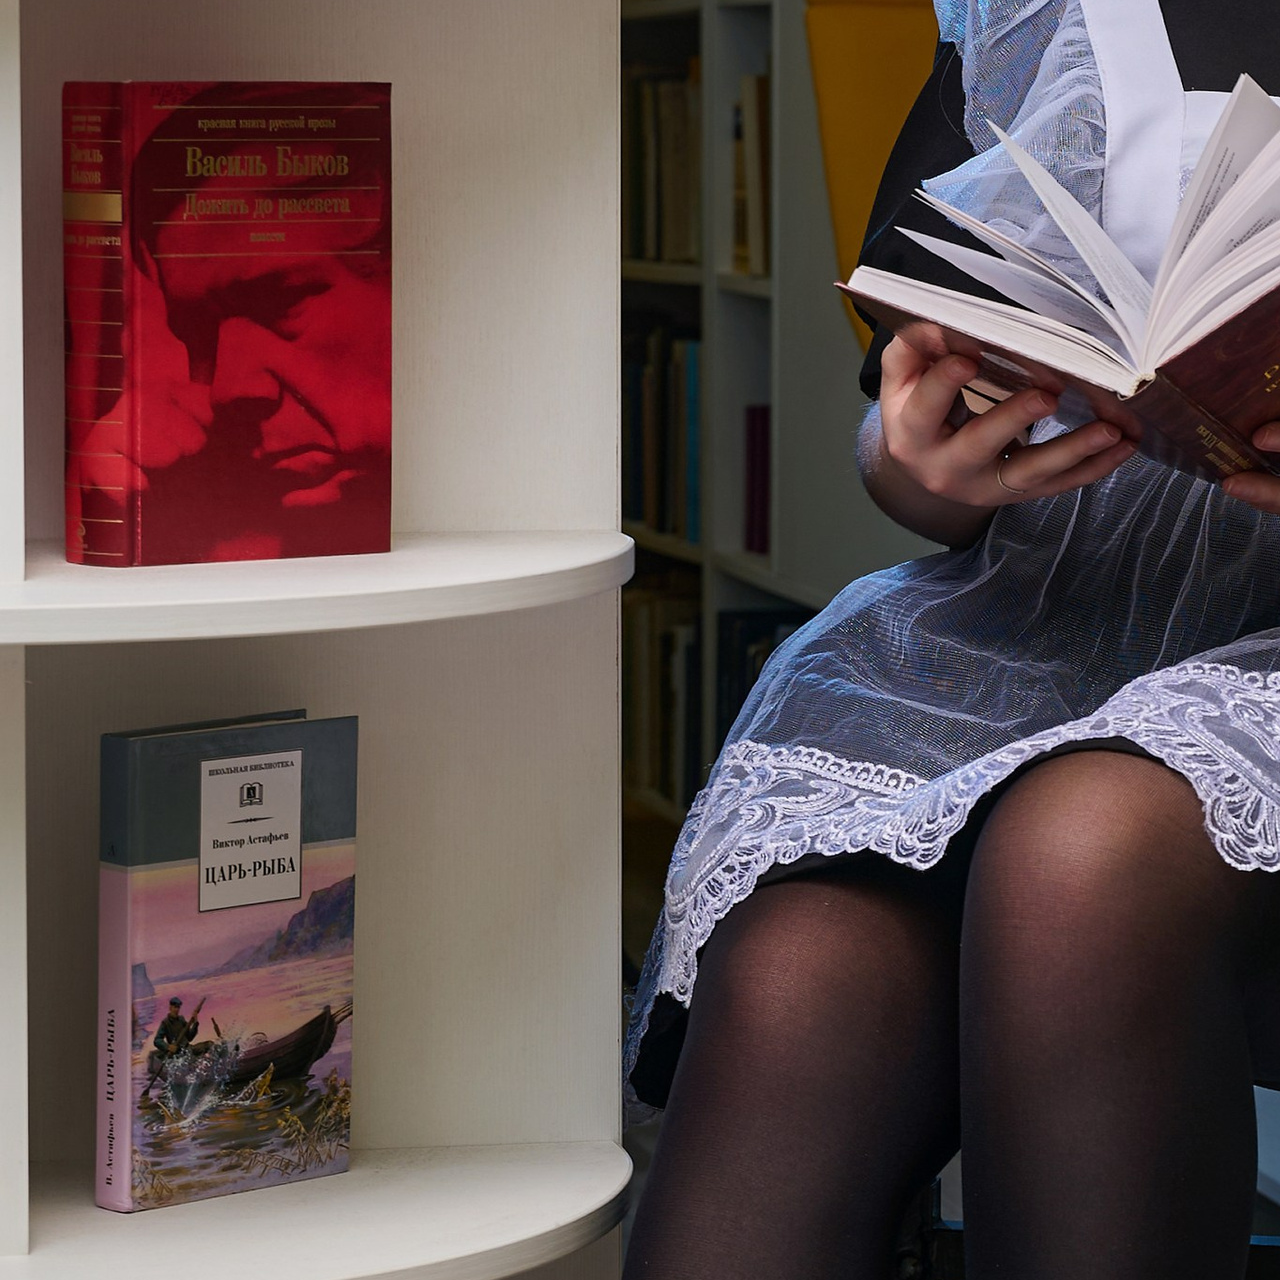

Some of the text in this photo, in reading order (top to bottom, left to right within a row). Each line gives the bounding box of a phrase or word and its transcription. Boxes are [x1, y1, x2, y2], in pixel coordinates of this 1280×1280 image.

[197, 116, 337, 132] красная книга русской прозы
[185, 147, 349, 177] Василь Быков
[183, 194, 350, 221] Дожить до рассвета
[208, 760, 294, 777] ШКОЛЬНАЯ БИБЛИОТЕКА
[212, 830, 290, 850] Виктор Астафьев
[204, 857, 296, 886] ЦАРЬ-РЫБА
[106, 1009, 116, 1102] ЦАРЬ-РЫБА
[105, 1113, 116, 1171] Астафьев
